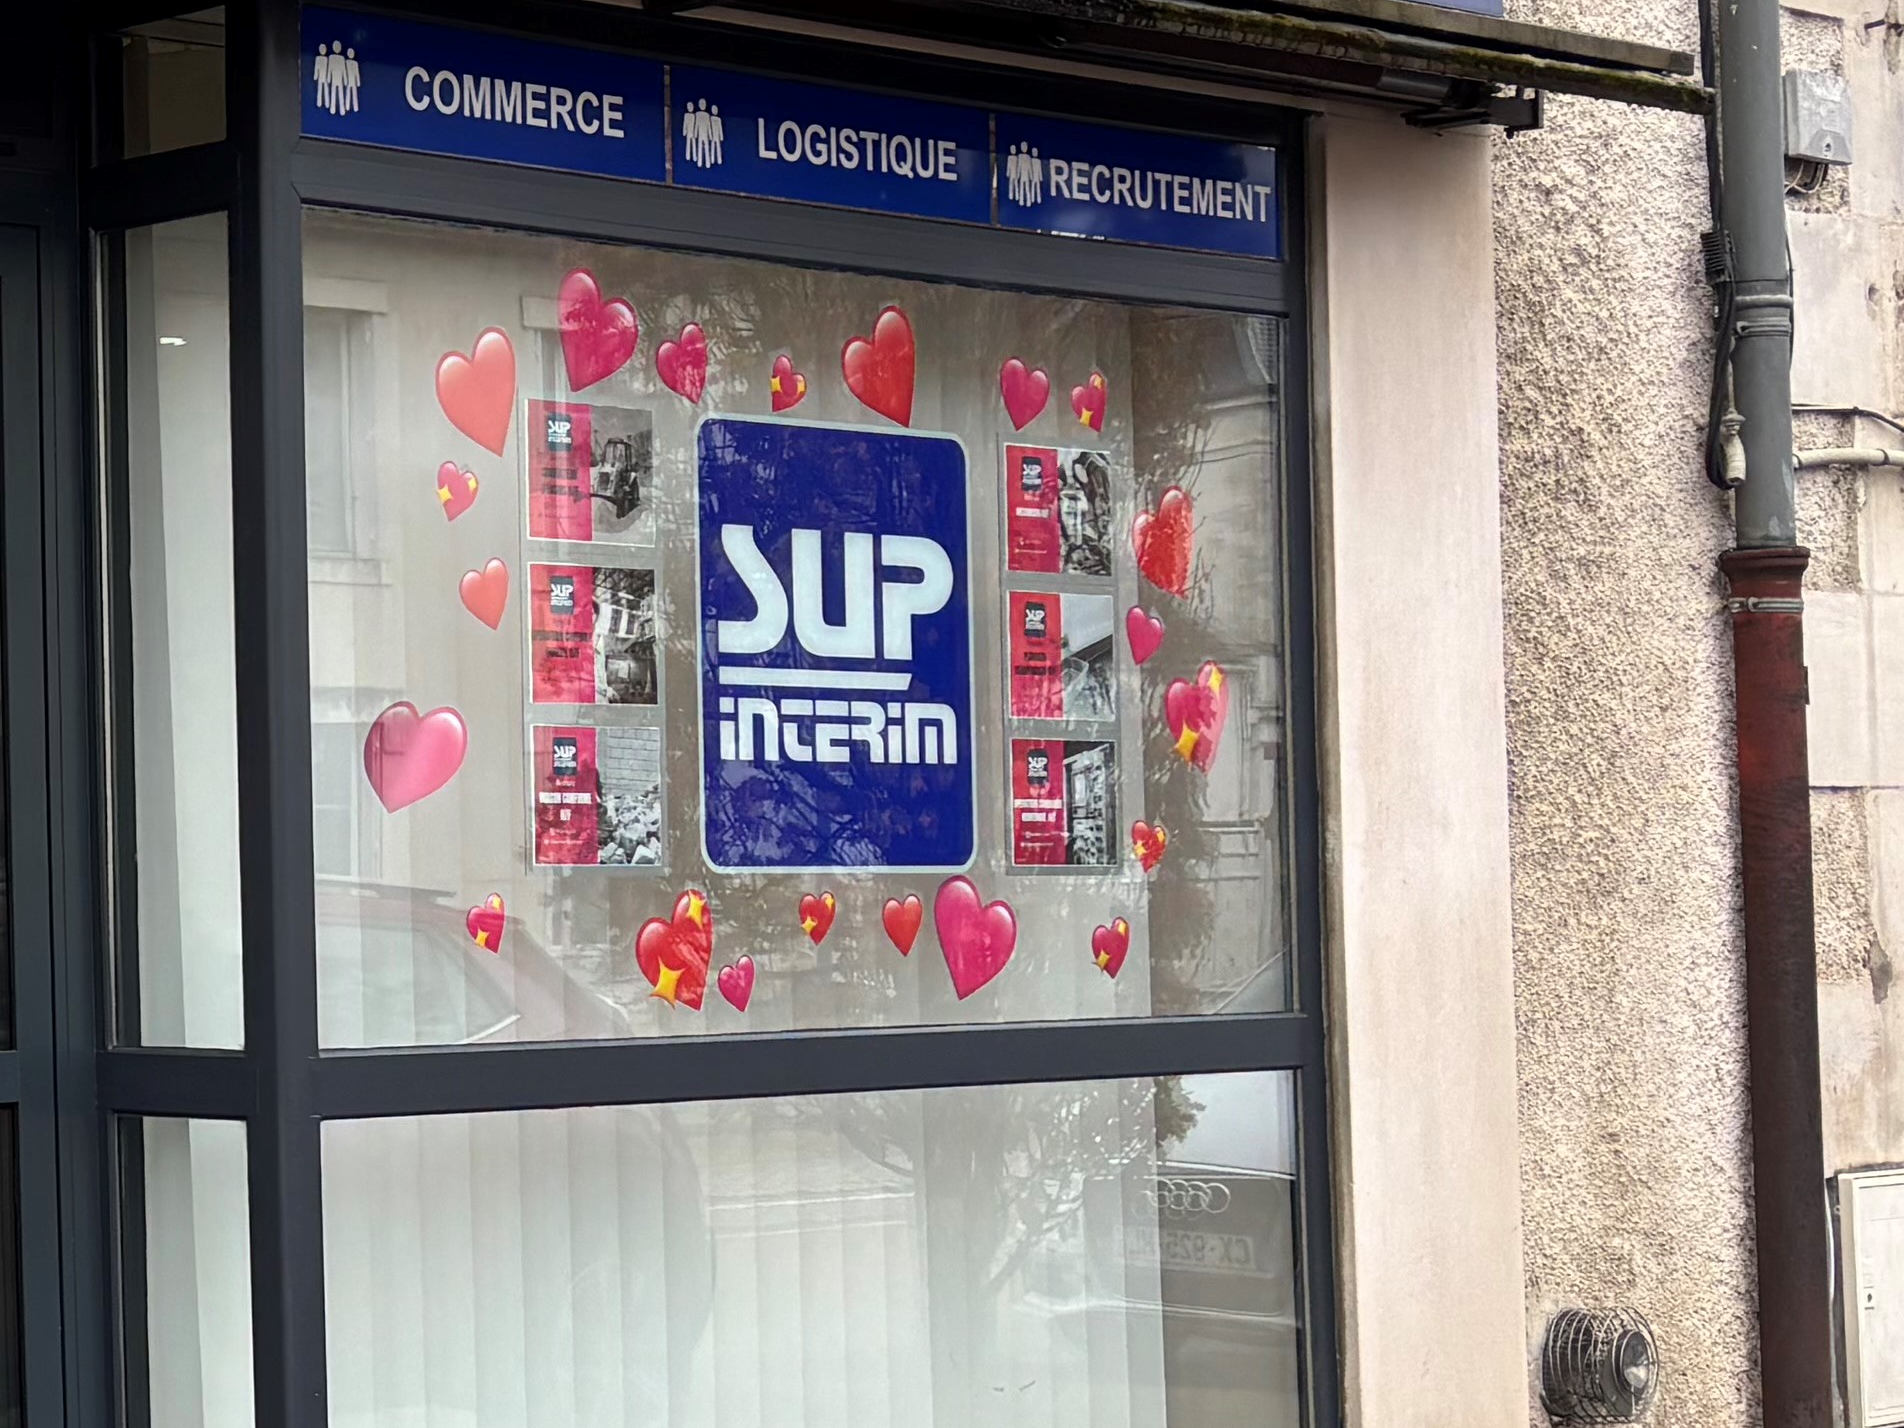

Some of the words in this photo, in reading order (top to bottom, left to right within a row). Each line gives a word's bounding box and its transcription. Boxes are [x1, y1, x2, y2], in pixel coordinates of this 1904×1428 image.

[405, 67, 624, 138] COMMERCE
[758, 118, 957, 180] LOGISTIQUE
[1050, 159, 1271, 222] RECRUTEMENT
[718, 524, 953, 660] SUP
